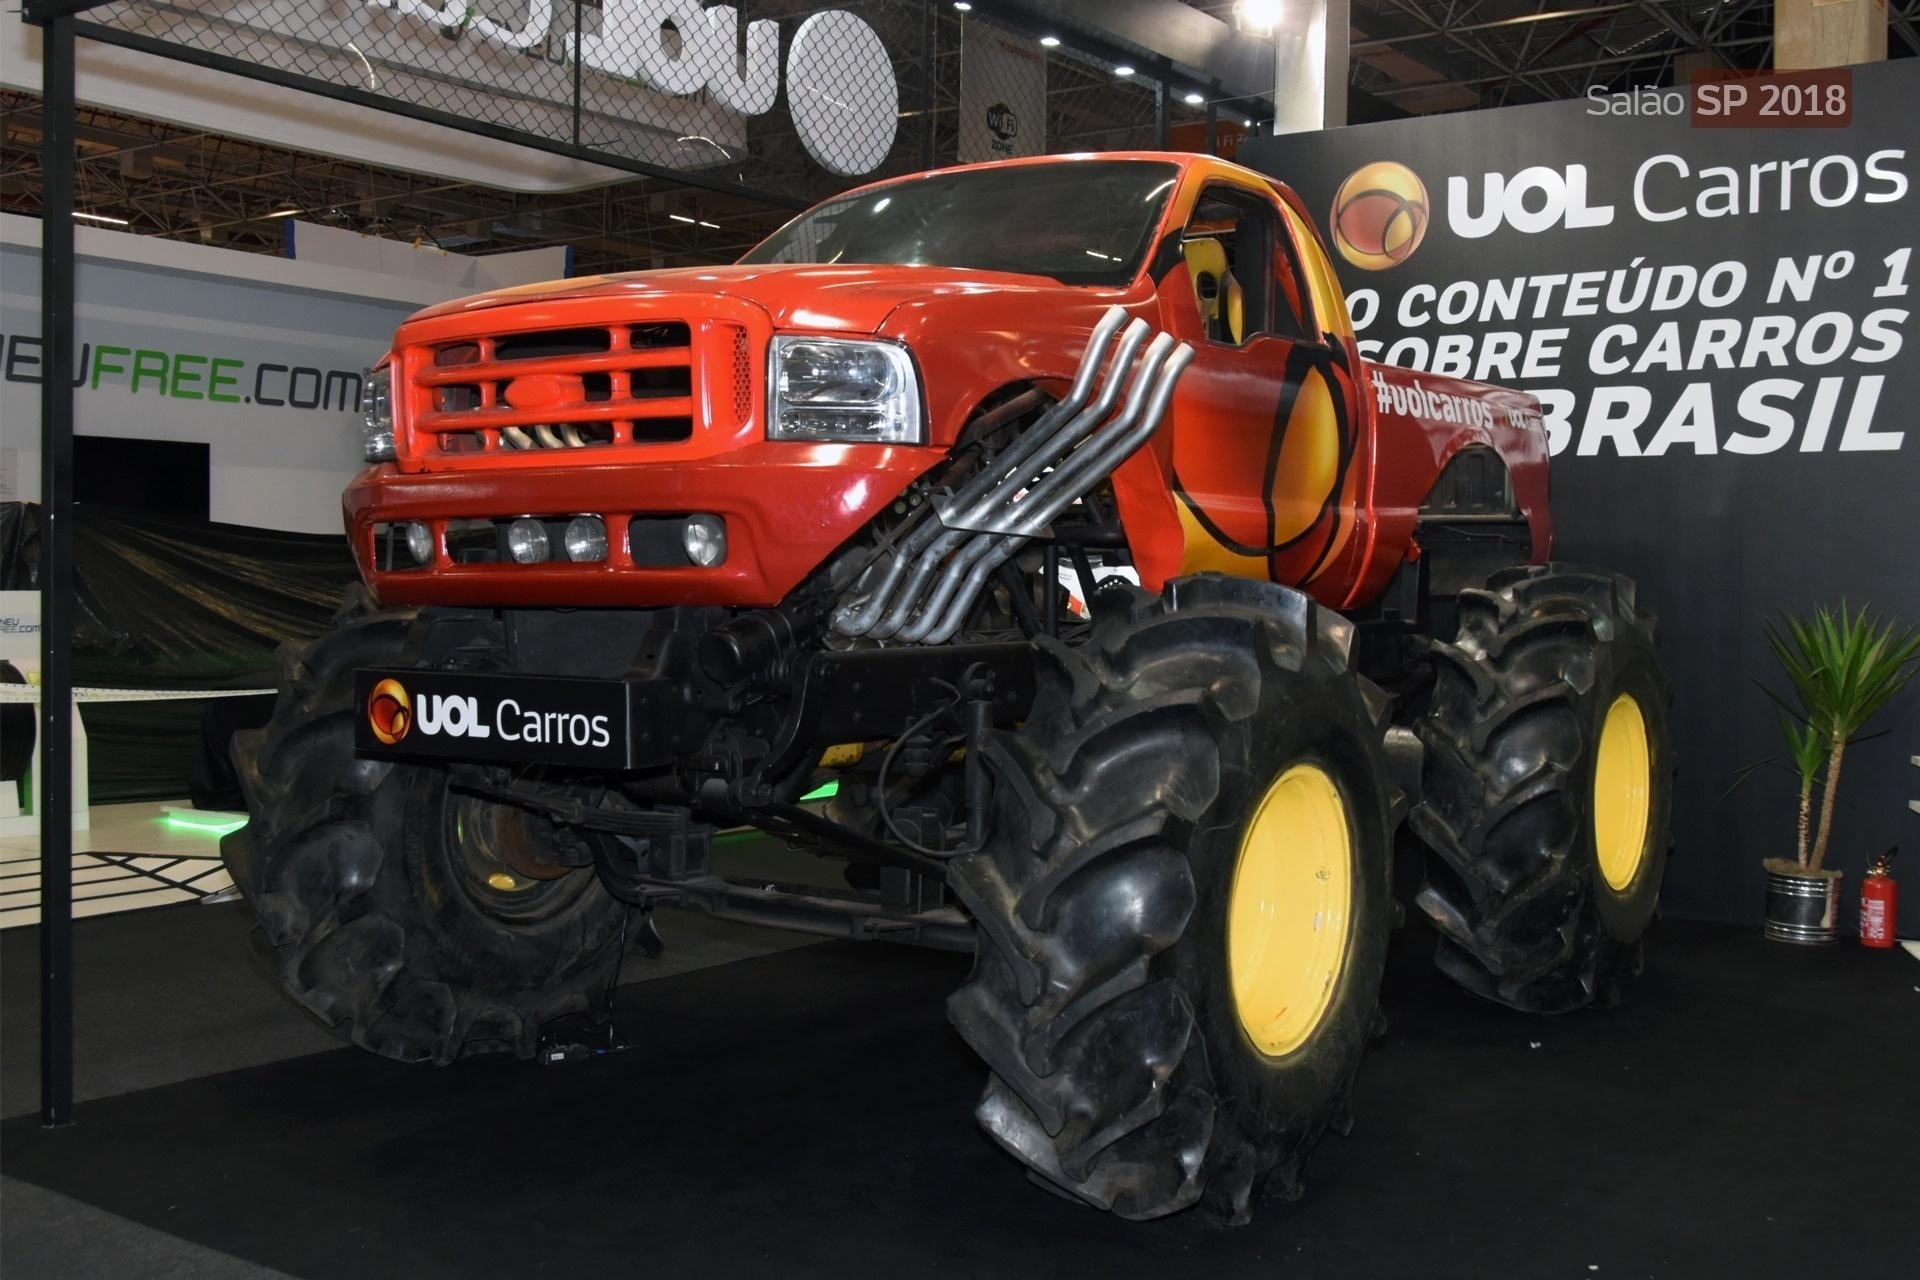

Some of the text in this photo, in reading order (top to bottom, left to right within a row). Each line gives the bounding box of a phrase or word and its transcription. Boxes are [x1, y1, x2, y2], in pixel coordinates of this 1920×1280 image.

[991, 139, 1014, 155] ZONE
[1447, 149, 1908, 239] UOL Carros
[1345, 288, 1380, 332] O
[1397, 256, 1747, 328] CONTEÚDO
[1872, 247, 1912, 298] 1
[0, 334, 364, 413] EFREE.COM
[1588, 308, 1911, 375] CARROS
[1372, 370, 1494, 430] #uolcarros
[1523, 374, 1906, 457] BRASIL
[416, 693, 610, 748] UOL Carros
